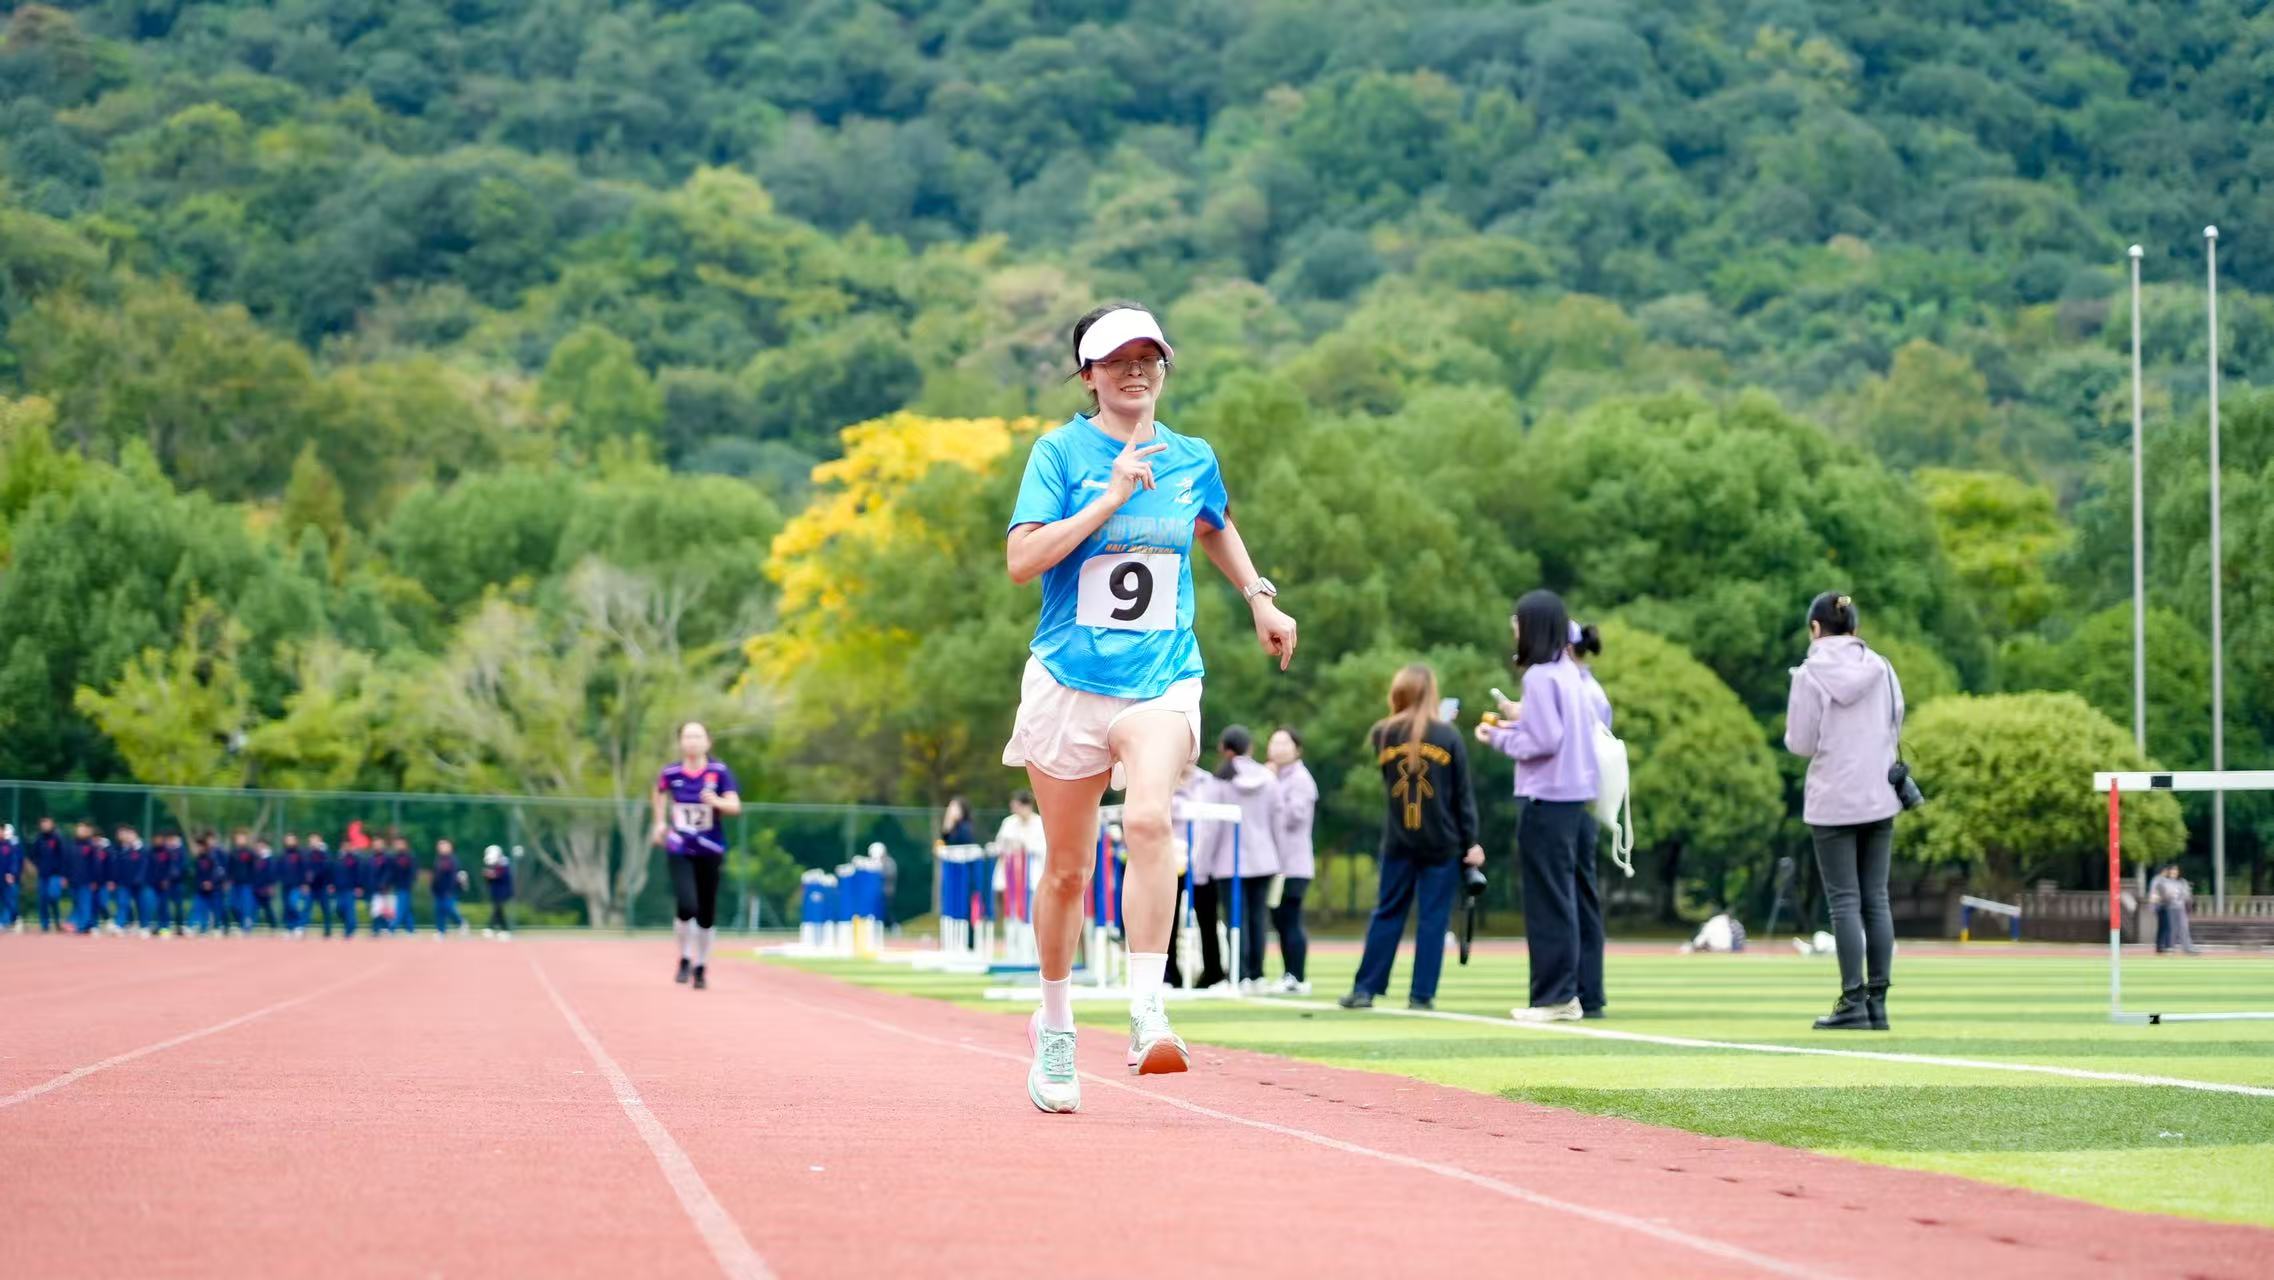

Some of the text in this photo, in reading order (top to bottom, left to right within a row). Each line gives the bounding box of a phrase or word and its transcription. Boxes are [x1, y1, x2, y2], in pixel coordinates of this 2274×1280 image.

[1105, 544, 1128, 553] HALF
[1109, 561, 1154, 621] 9
[683, 807, 706, 826] 12
